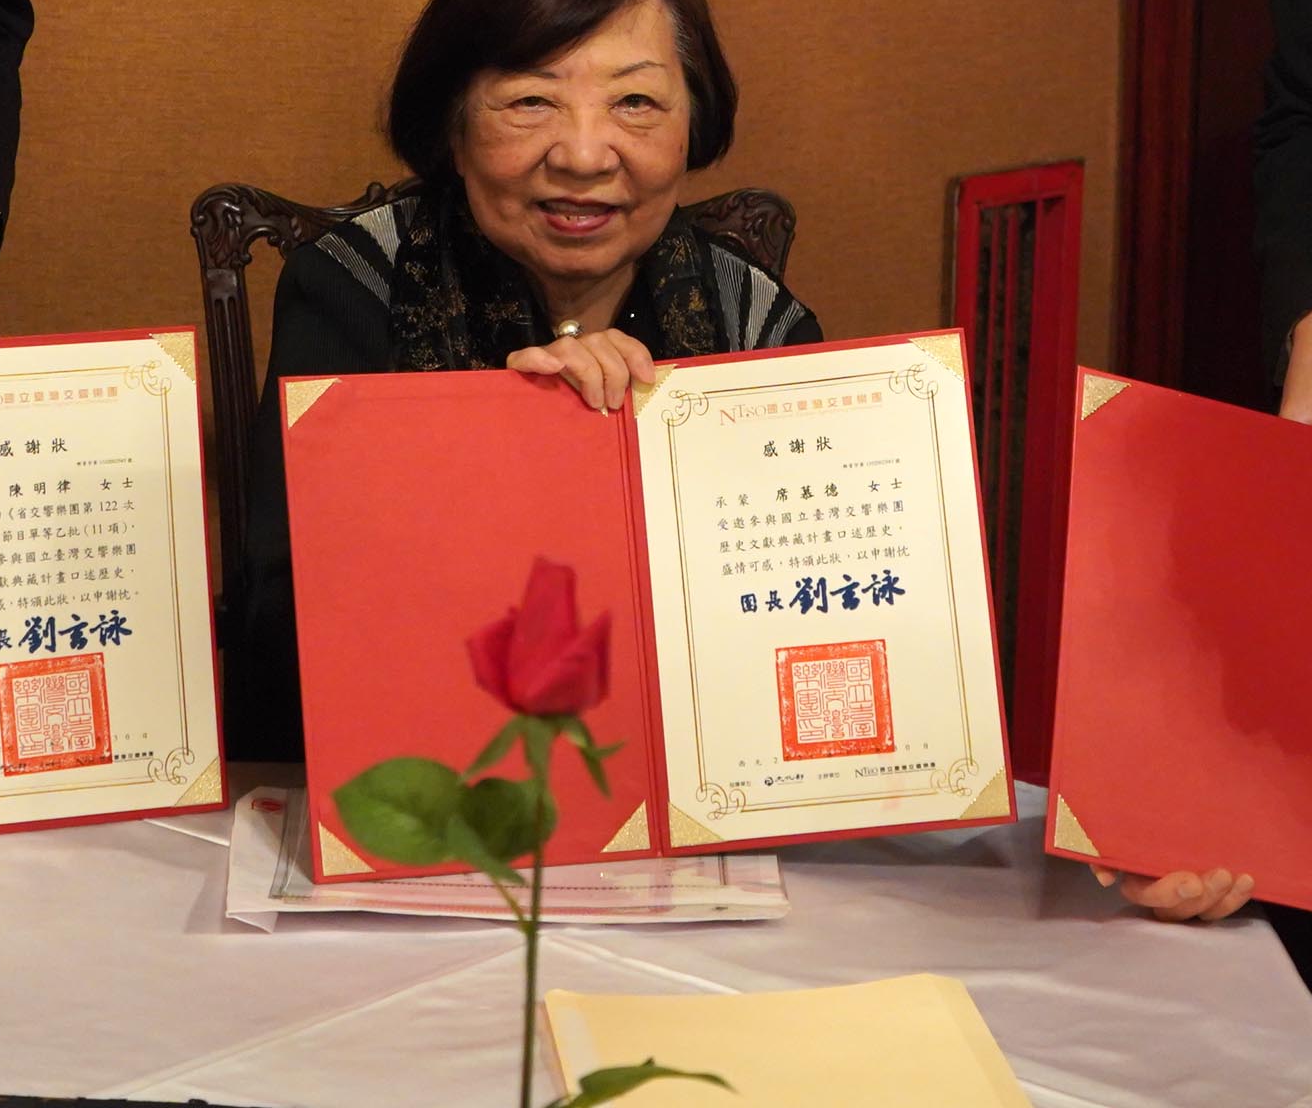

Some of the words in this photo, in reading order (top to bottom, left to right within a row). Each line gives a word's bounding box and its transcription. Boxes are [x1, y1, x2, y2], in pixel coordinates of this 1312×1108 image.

[762, 436, 833, 458] 感謝狀
[8, 479, 72, 497] 陳明律
[99, 477, 135, 491] 女士
[715, 493, 750, 507] 承蒙
[867, 477, 903, 493] 女士
